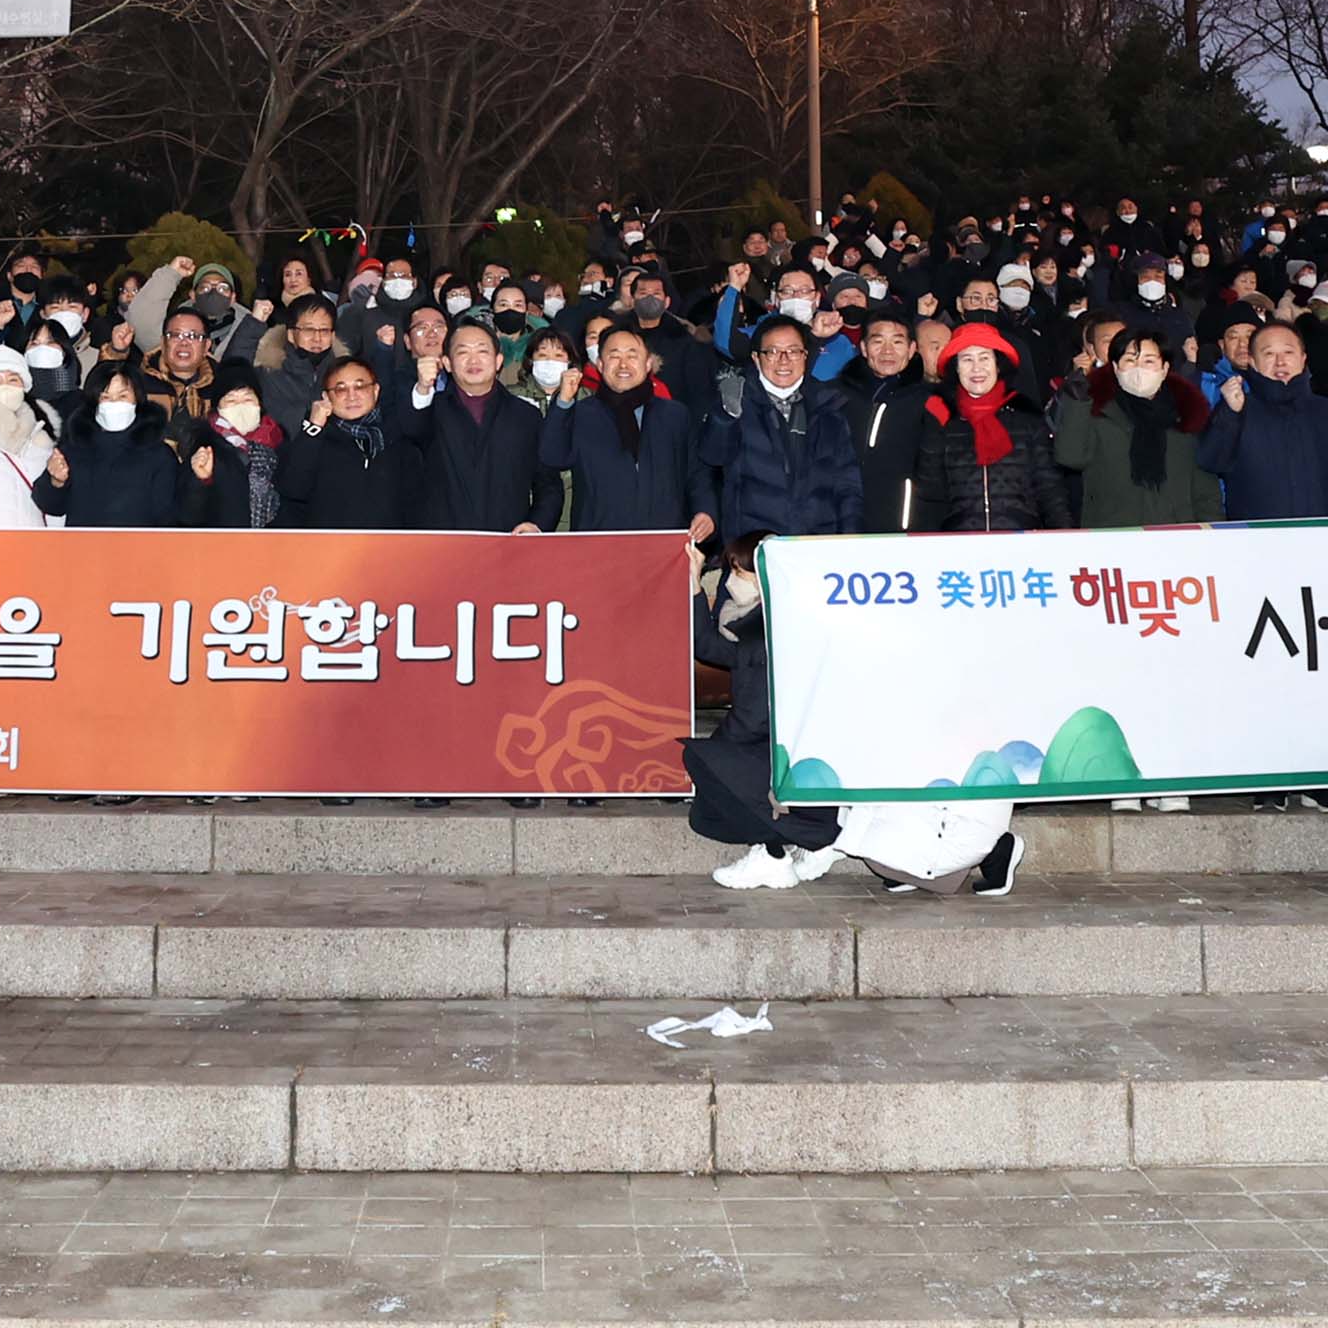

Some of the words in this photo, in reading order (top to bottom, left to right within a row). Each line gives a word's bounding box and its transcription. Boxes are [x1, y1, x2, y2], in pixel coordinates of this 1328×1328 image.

[110, 597, 578, 685] 기원합니다
[823, 572, 919, 606] 2023
[936, 568, 1058, 609] 癸卯年
[1070, 566, 1220, 638] 해맞이
